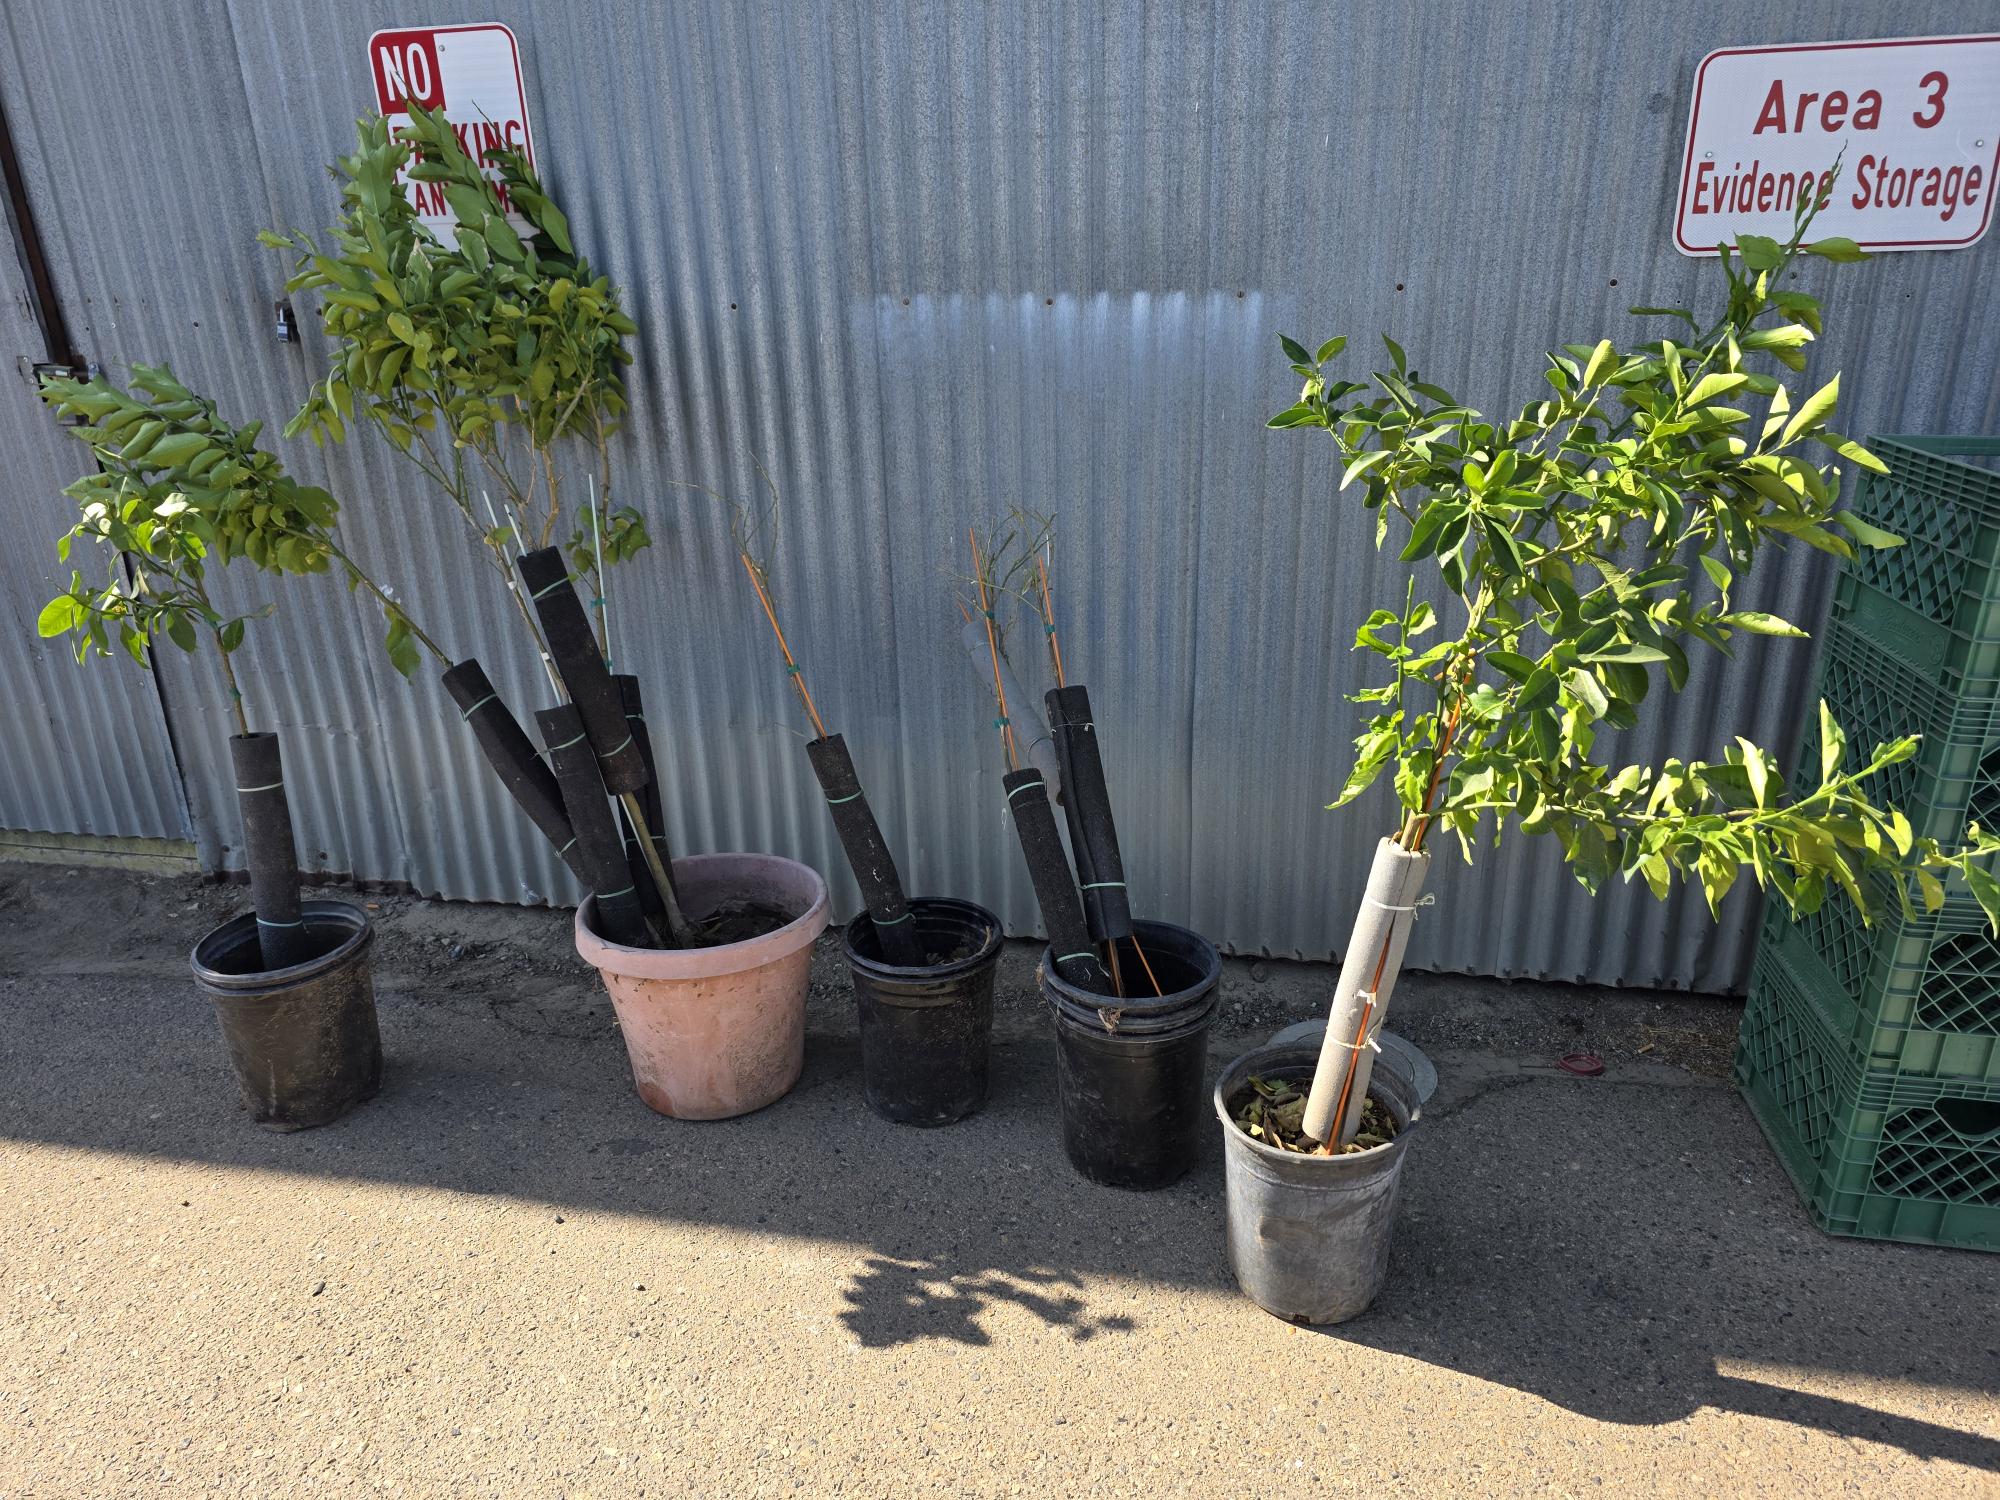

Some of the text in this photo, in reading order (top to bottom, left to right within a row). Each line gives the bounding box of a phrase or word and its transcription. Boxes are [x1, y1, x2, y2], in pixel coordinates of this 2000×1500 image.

[380, 42, 432, 101] NO
[1753, 70, 1949, 134] Area 3
[393, 119, 524, 171] KING
[1691, 154, 1983, 222] Evidence Storage
